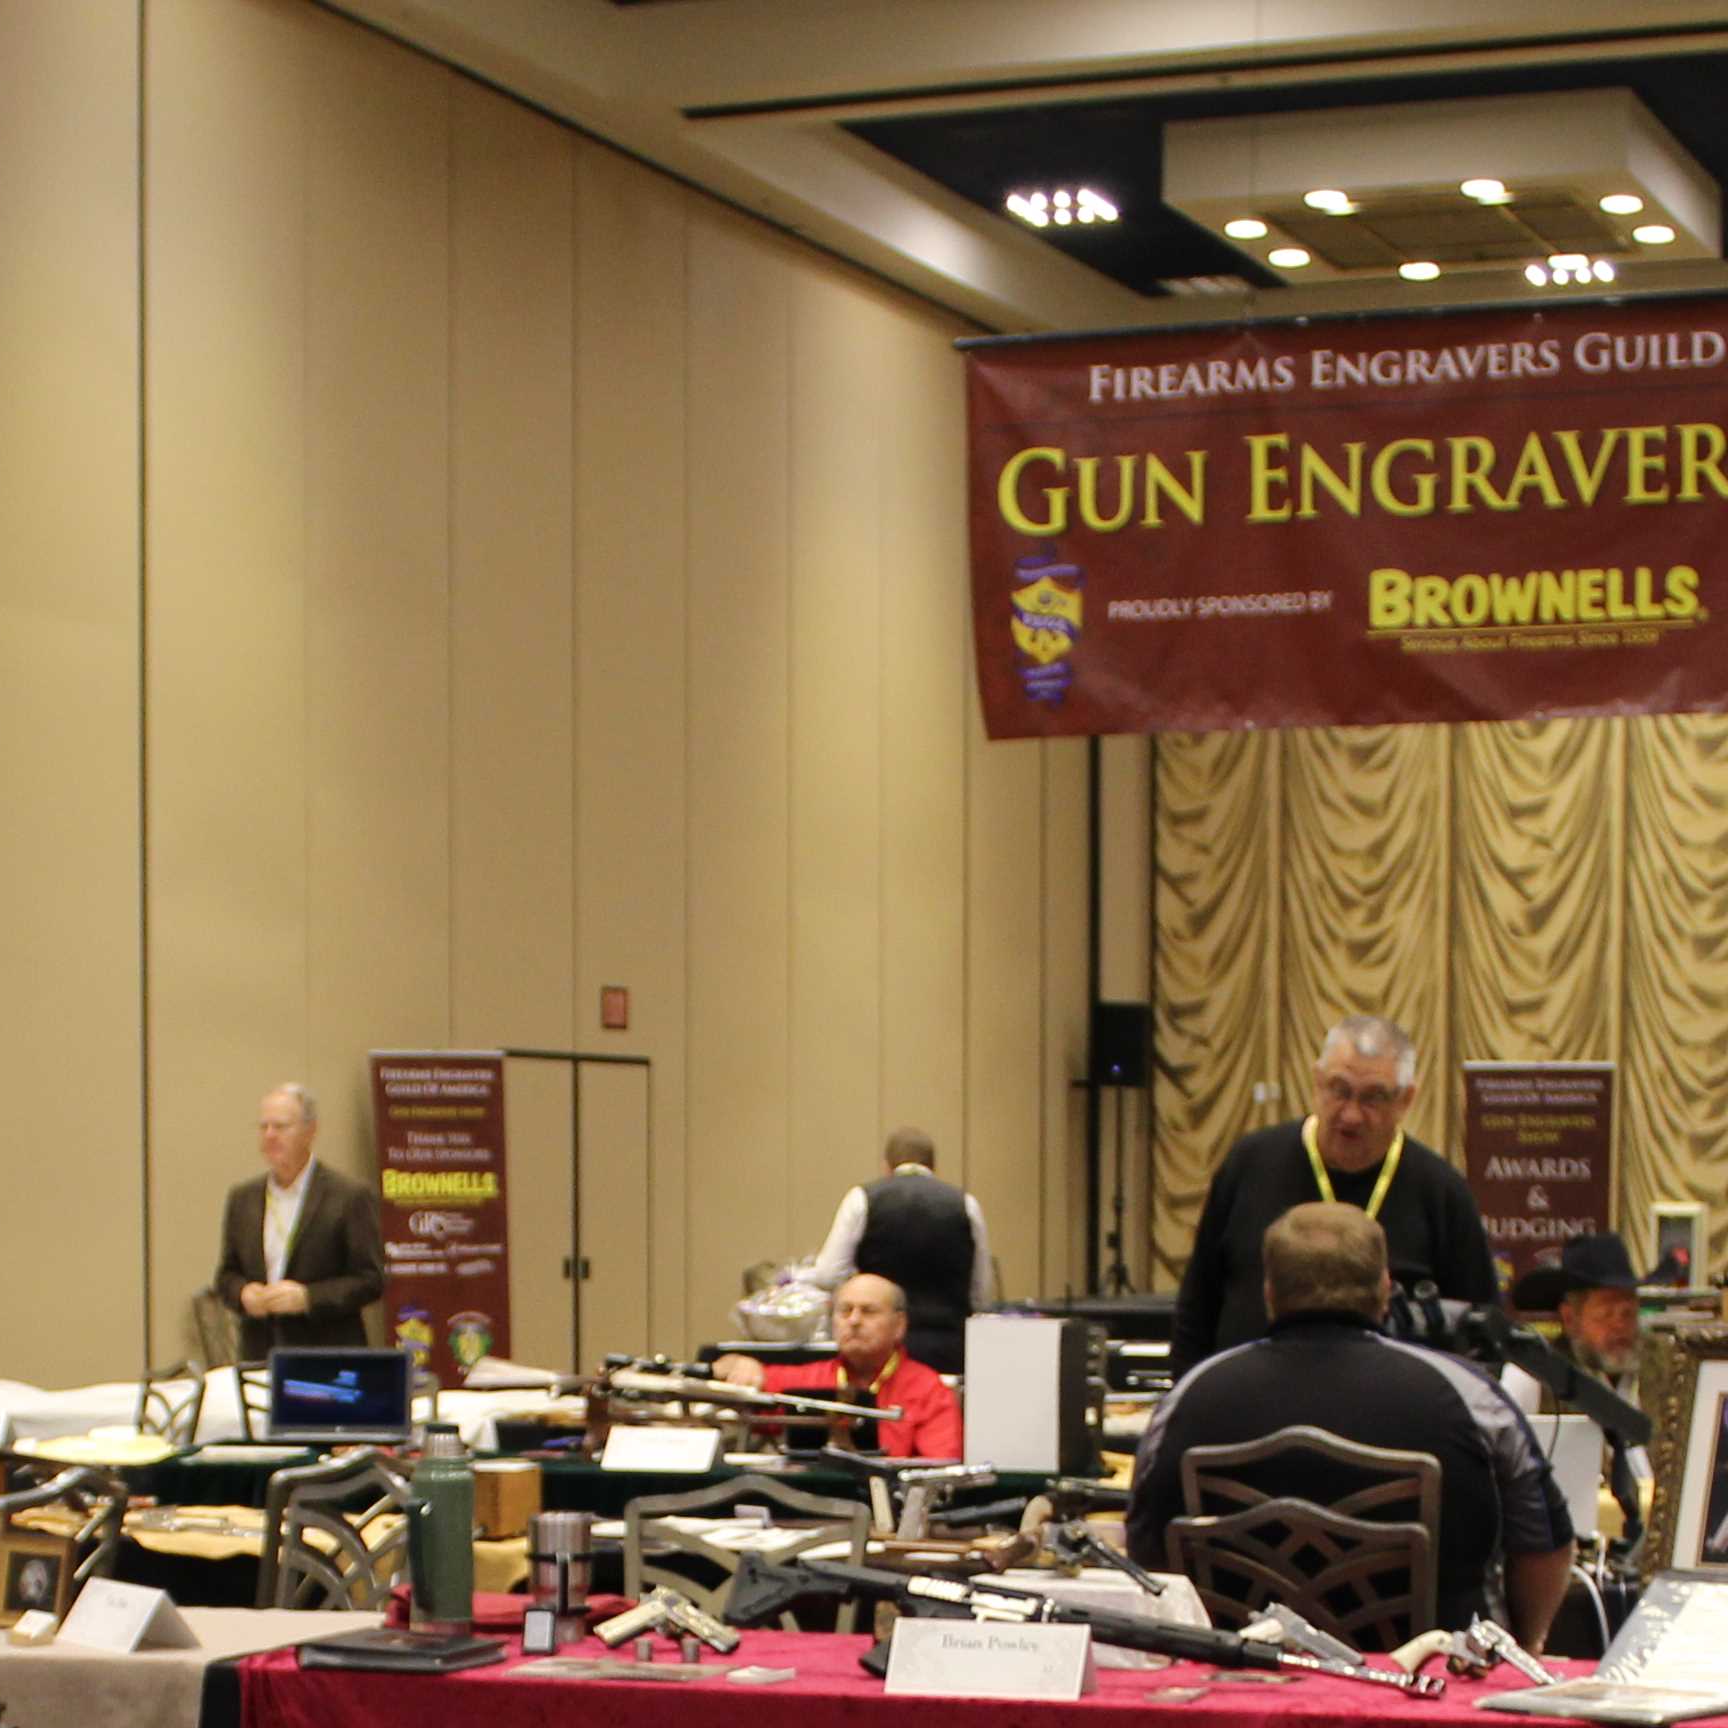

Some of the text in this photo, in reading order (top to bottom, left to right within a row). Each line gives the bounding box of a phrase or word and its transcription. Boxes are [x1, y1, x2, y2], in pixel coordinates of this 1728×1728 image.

[1088, 356, 1295, 403] FIREARMS
[1310, 340, 1559, 389] ENGRAVERS
[1572, 331, 1725, 374] GUILD
[996, 445, 1208, 537] GUN
[1108, 598, 1192, 621] PROUDLY
[1196, 592, 1306, 618] SPONSORED
[1369, 565, 1700, 628] BROWNELLS
[1484, 1156, 1592, 1180] AWARDS
[382, 1169, 498, 1198] BROWNELLS
[1526, 1184, 1550, 1210] &
